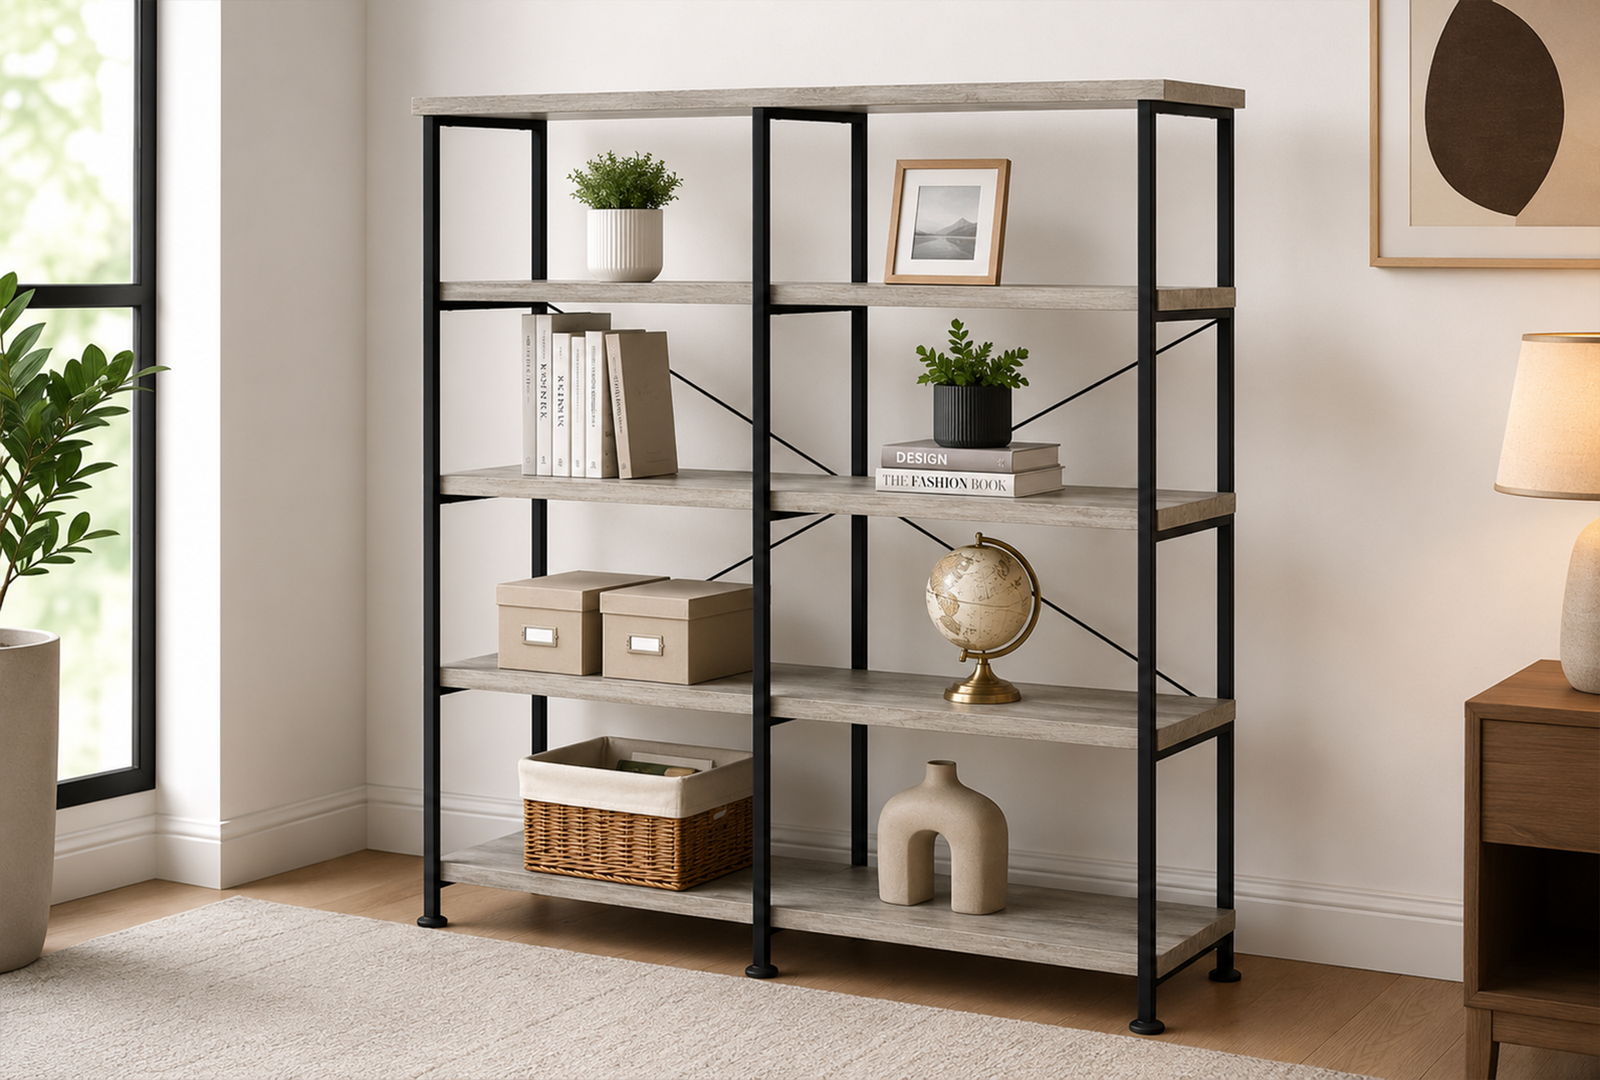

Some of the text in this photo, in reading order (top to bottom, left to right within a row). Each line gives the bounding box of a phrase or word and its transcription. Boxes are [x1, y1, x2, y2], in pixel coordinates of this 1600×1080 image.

[896, 451, 948, 465] DESIGN
[882, 474, 1007, 492] THE FASHION BOOK
